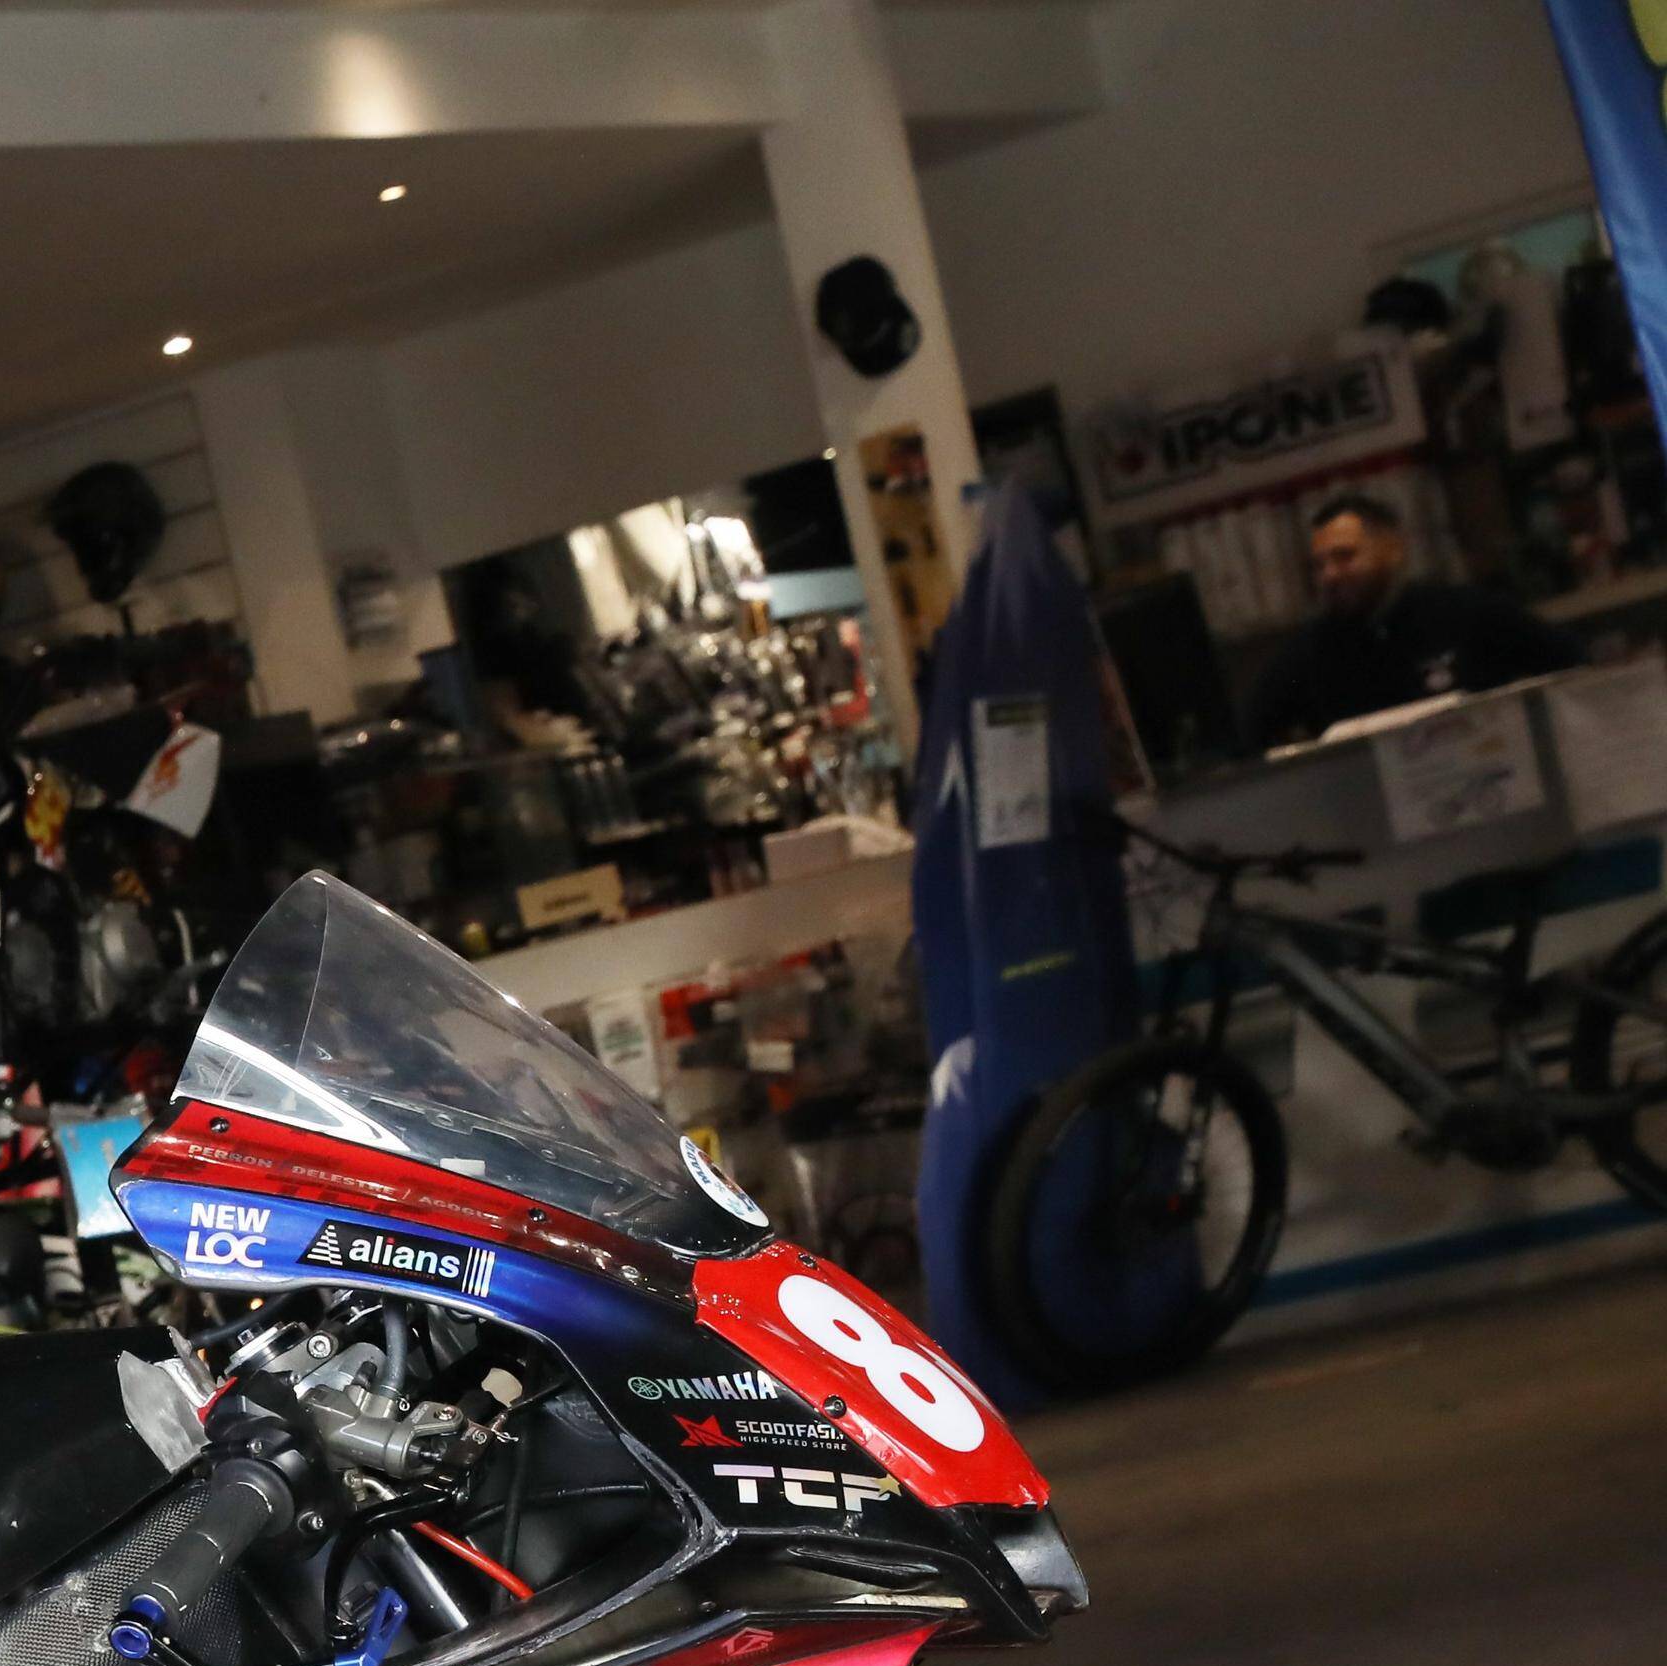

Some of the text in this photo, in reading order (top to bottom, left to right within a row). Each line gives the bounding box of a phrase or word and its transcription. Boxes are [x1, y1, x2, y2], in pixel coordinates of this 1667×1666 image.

[189, 1203, 272, 1232] NEW
[184, 1230, 266, 1269] LOC
[348, 1236, 461, 1279] alians
[777, 1274, 986, 1453] 8
[664, 1369, 779, 1401] YAMAHA
[740, 1435, 848, 1451] HIGH SPEED STORE
[713, 1463, 893, 1513] TCP
